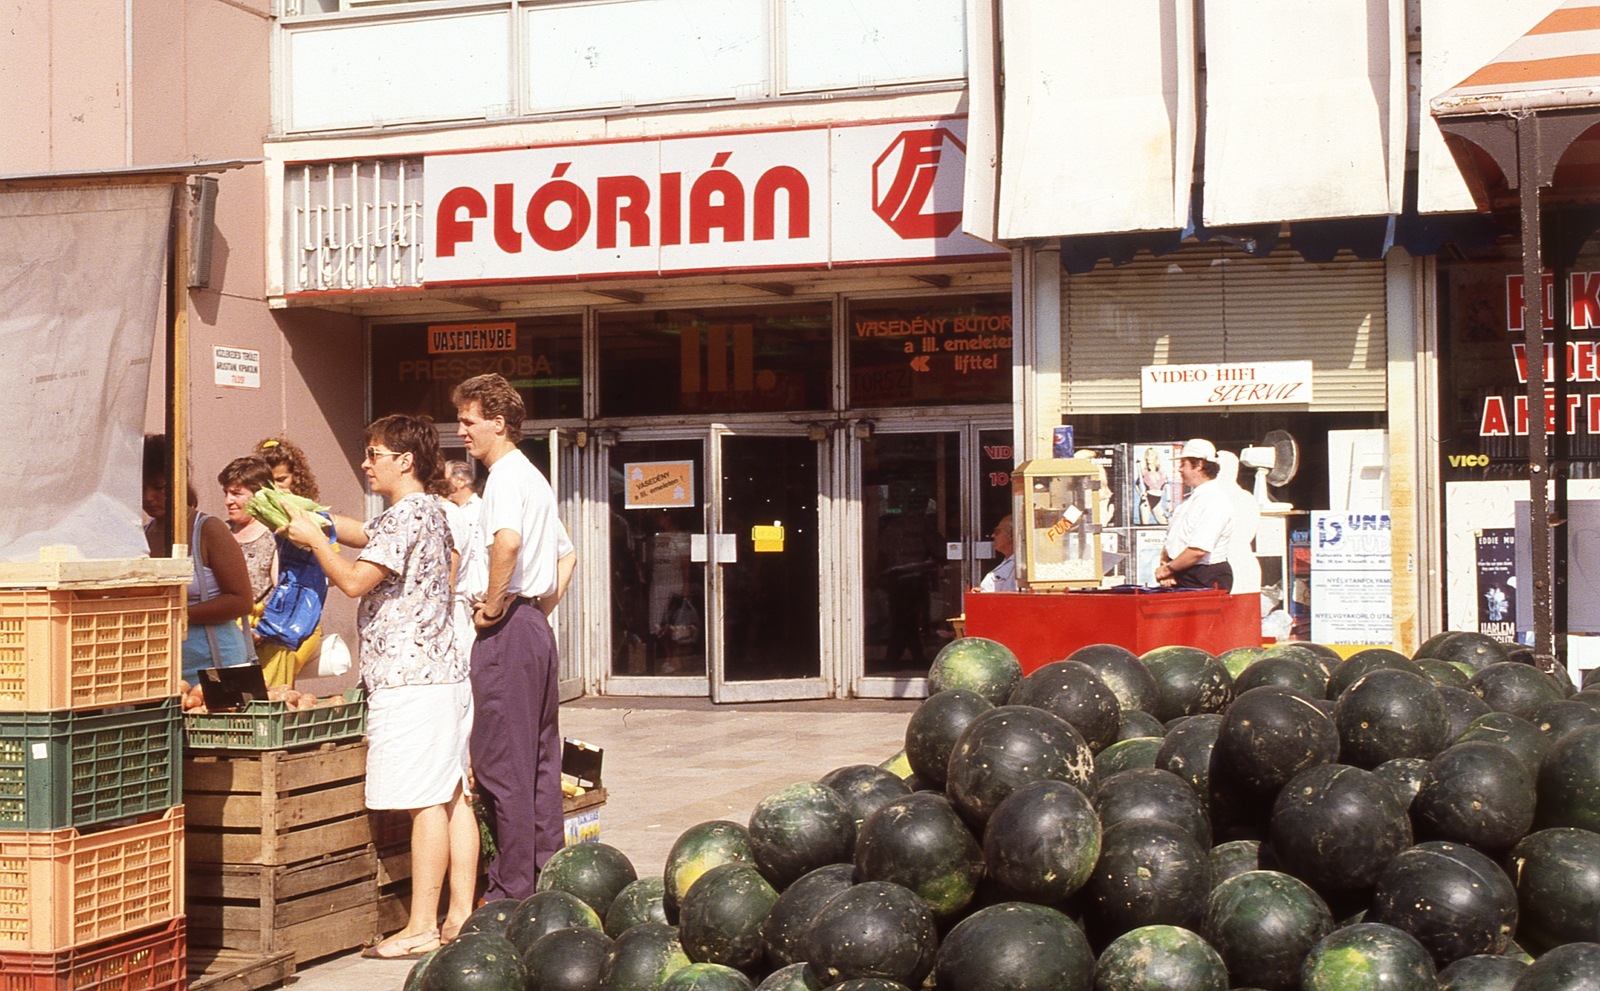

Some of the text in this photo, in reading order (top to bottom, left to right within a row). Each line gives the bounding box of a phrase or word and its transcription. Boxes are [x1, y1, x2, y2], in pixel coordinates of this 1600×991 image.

[436, 151, 810, 257] FLÓRIÁN
[856, 317, 947, 337] VASEDÉNY
[433, 327, 512, 351] VASEDÉNYBE
[904, 341, 914, 353] a
[923, 336, 939, 352] III.
[954, 354, 998, 374] lifttel
[1208, 382, 1303, 403] SZERVIZ
[1479, 396, 1509, 436] A
[1448, 454, 1490, 468] VICO
[1480, 622, 1515, 636] HARLEM
